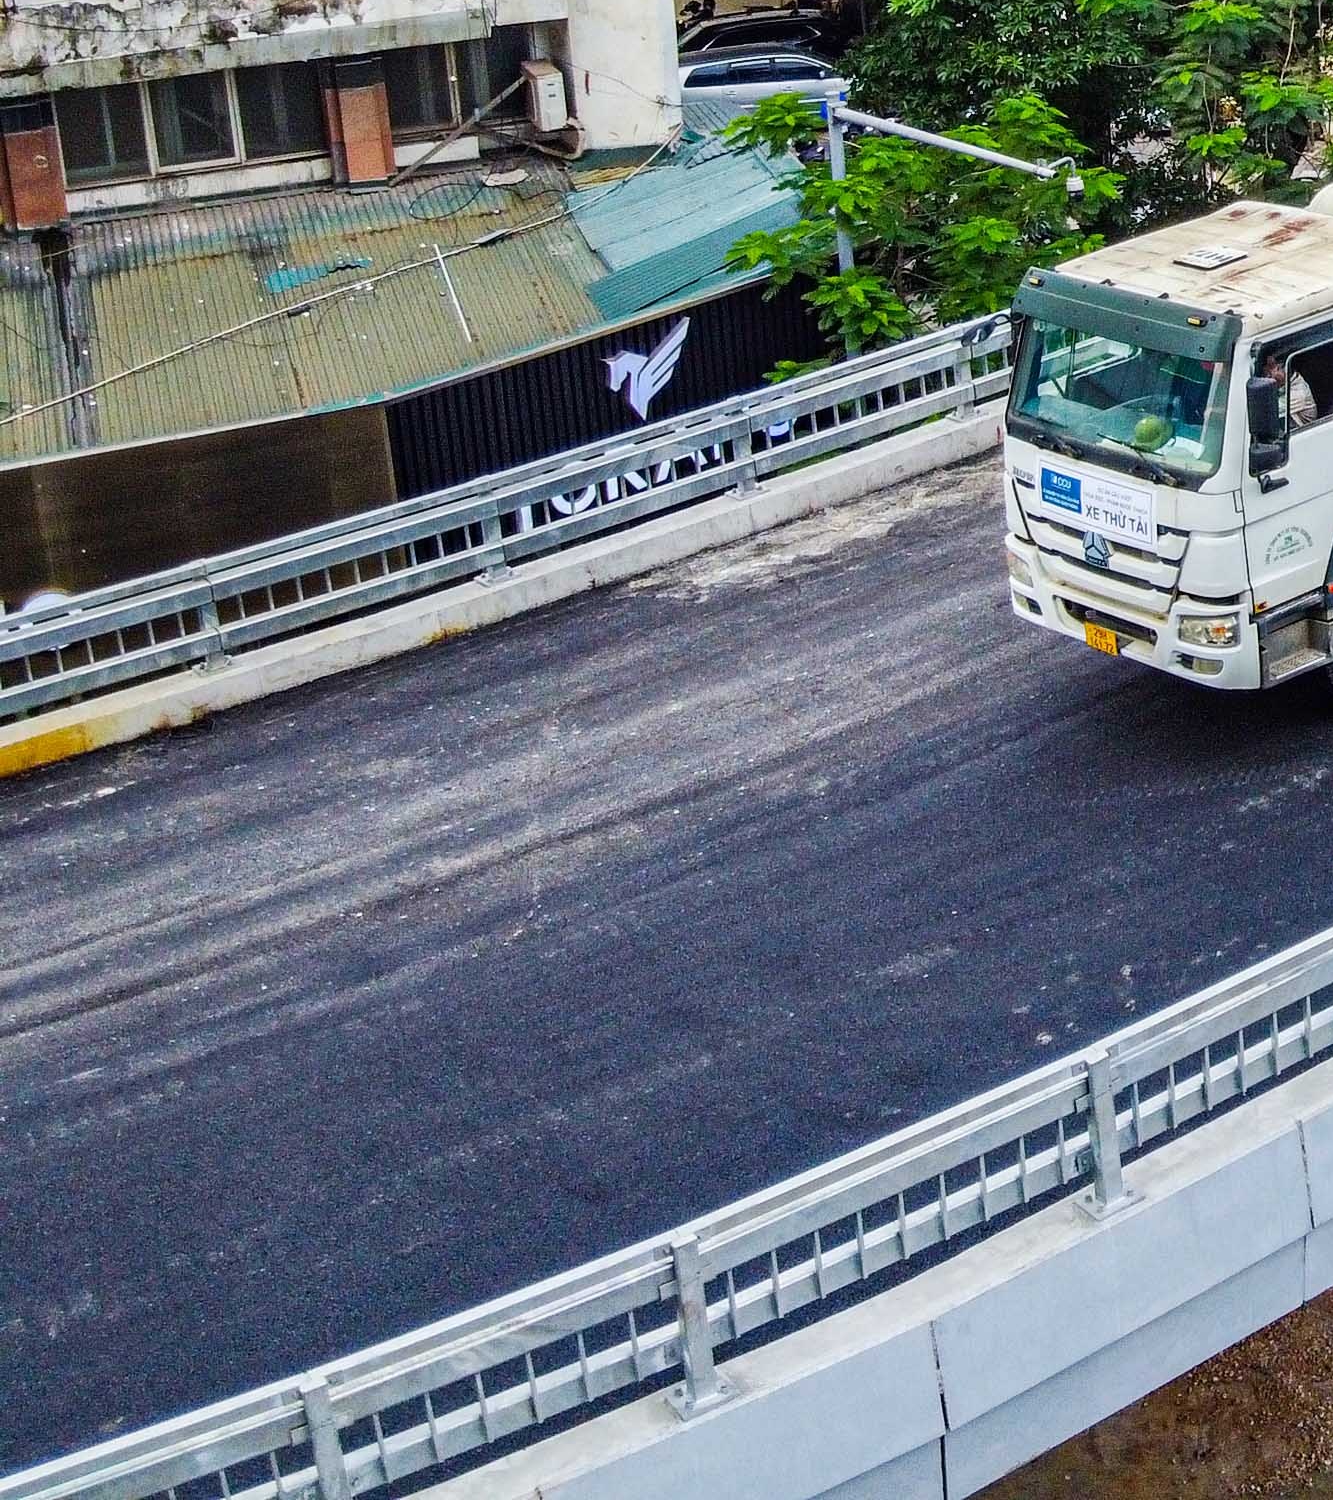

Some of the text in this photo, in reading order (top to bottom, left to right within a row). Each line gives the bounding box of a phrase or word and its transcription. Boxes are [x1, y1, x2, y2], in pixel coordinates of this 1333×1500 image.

[1086, 504, 1148, 536] XE THỬ TẢI
